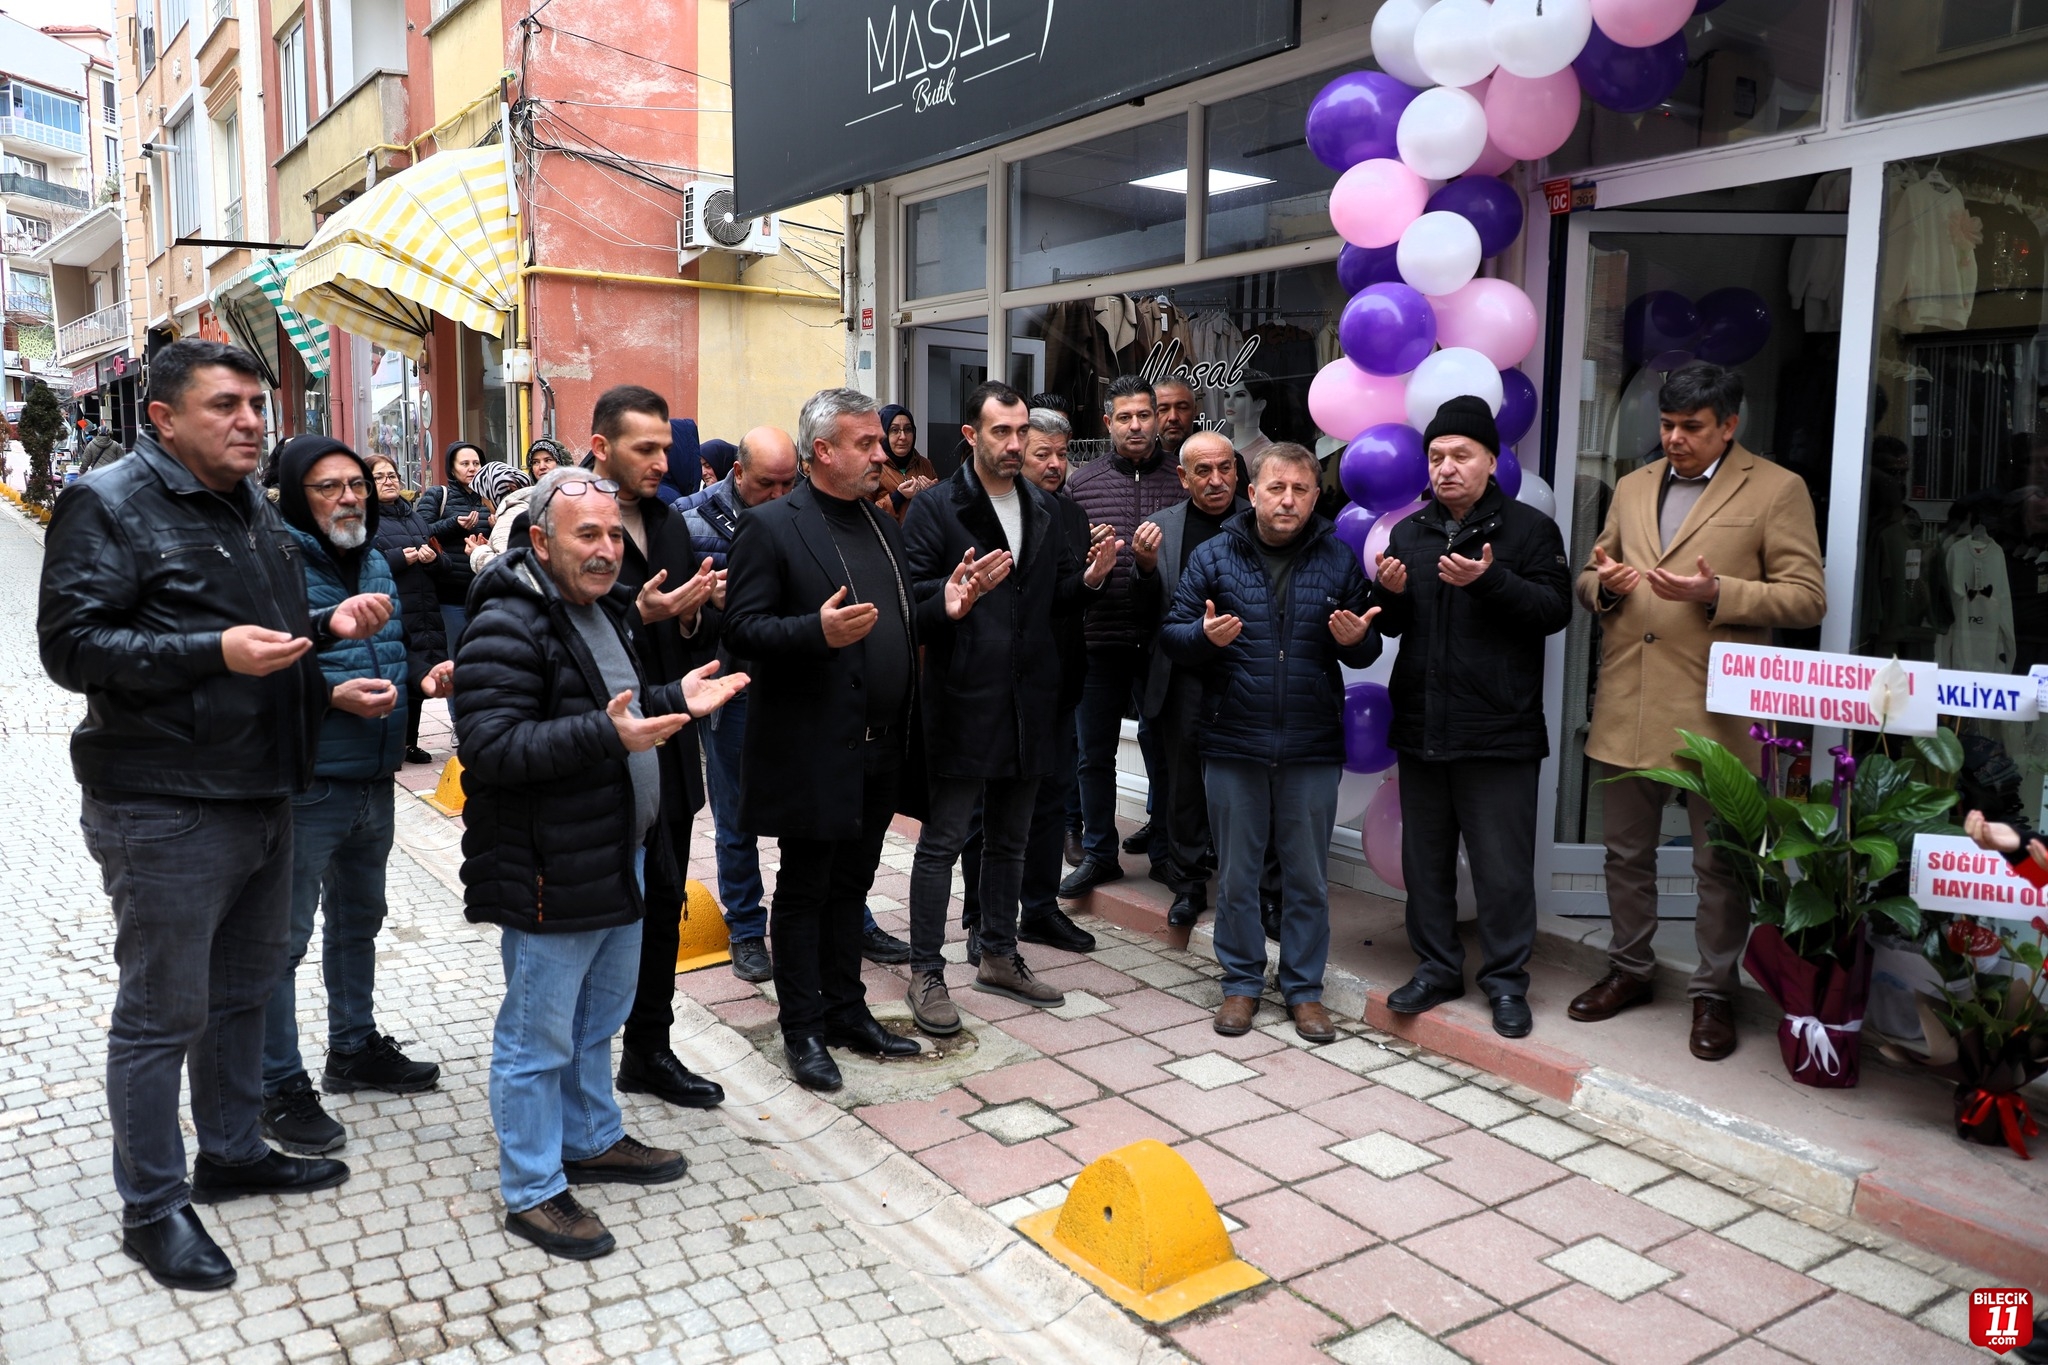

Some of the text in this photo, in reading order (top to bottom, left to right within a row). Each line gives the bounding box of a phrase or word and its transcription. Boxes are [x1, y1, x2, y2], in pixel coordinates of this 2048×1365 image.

[867, 0, 1011, 94] MASAL
[912, 66, 957, 114] Butik
[1722, 653, 1755, 678] CAN
[1760, 654, 1804, 684] OĞLU
[1807, 659, 1914, 696] AİLESİN
[1750, 689, 1815, 718] HAYIRLI
[1928, 850, 2000, 876] SÖĞÜT
[1932, 878, 2048, 908] HAYIRLI OL
